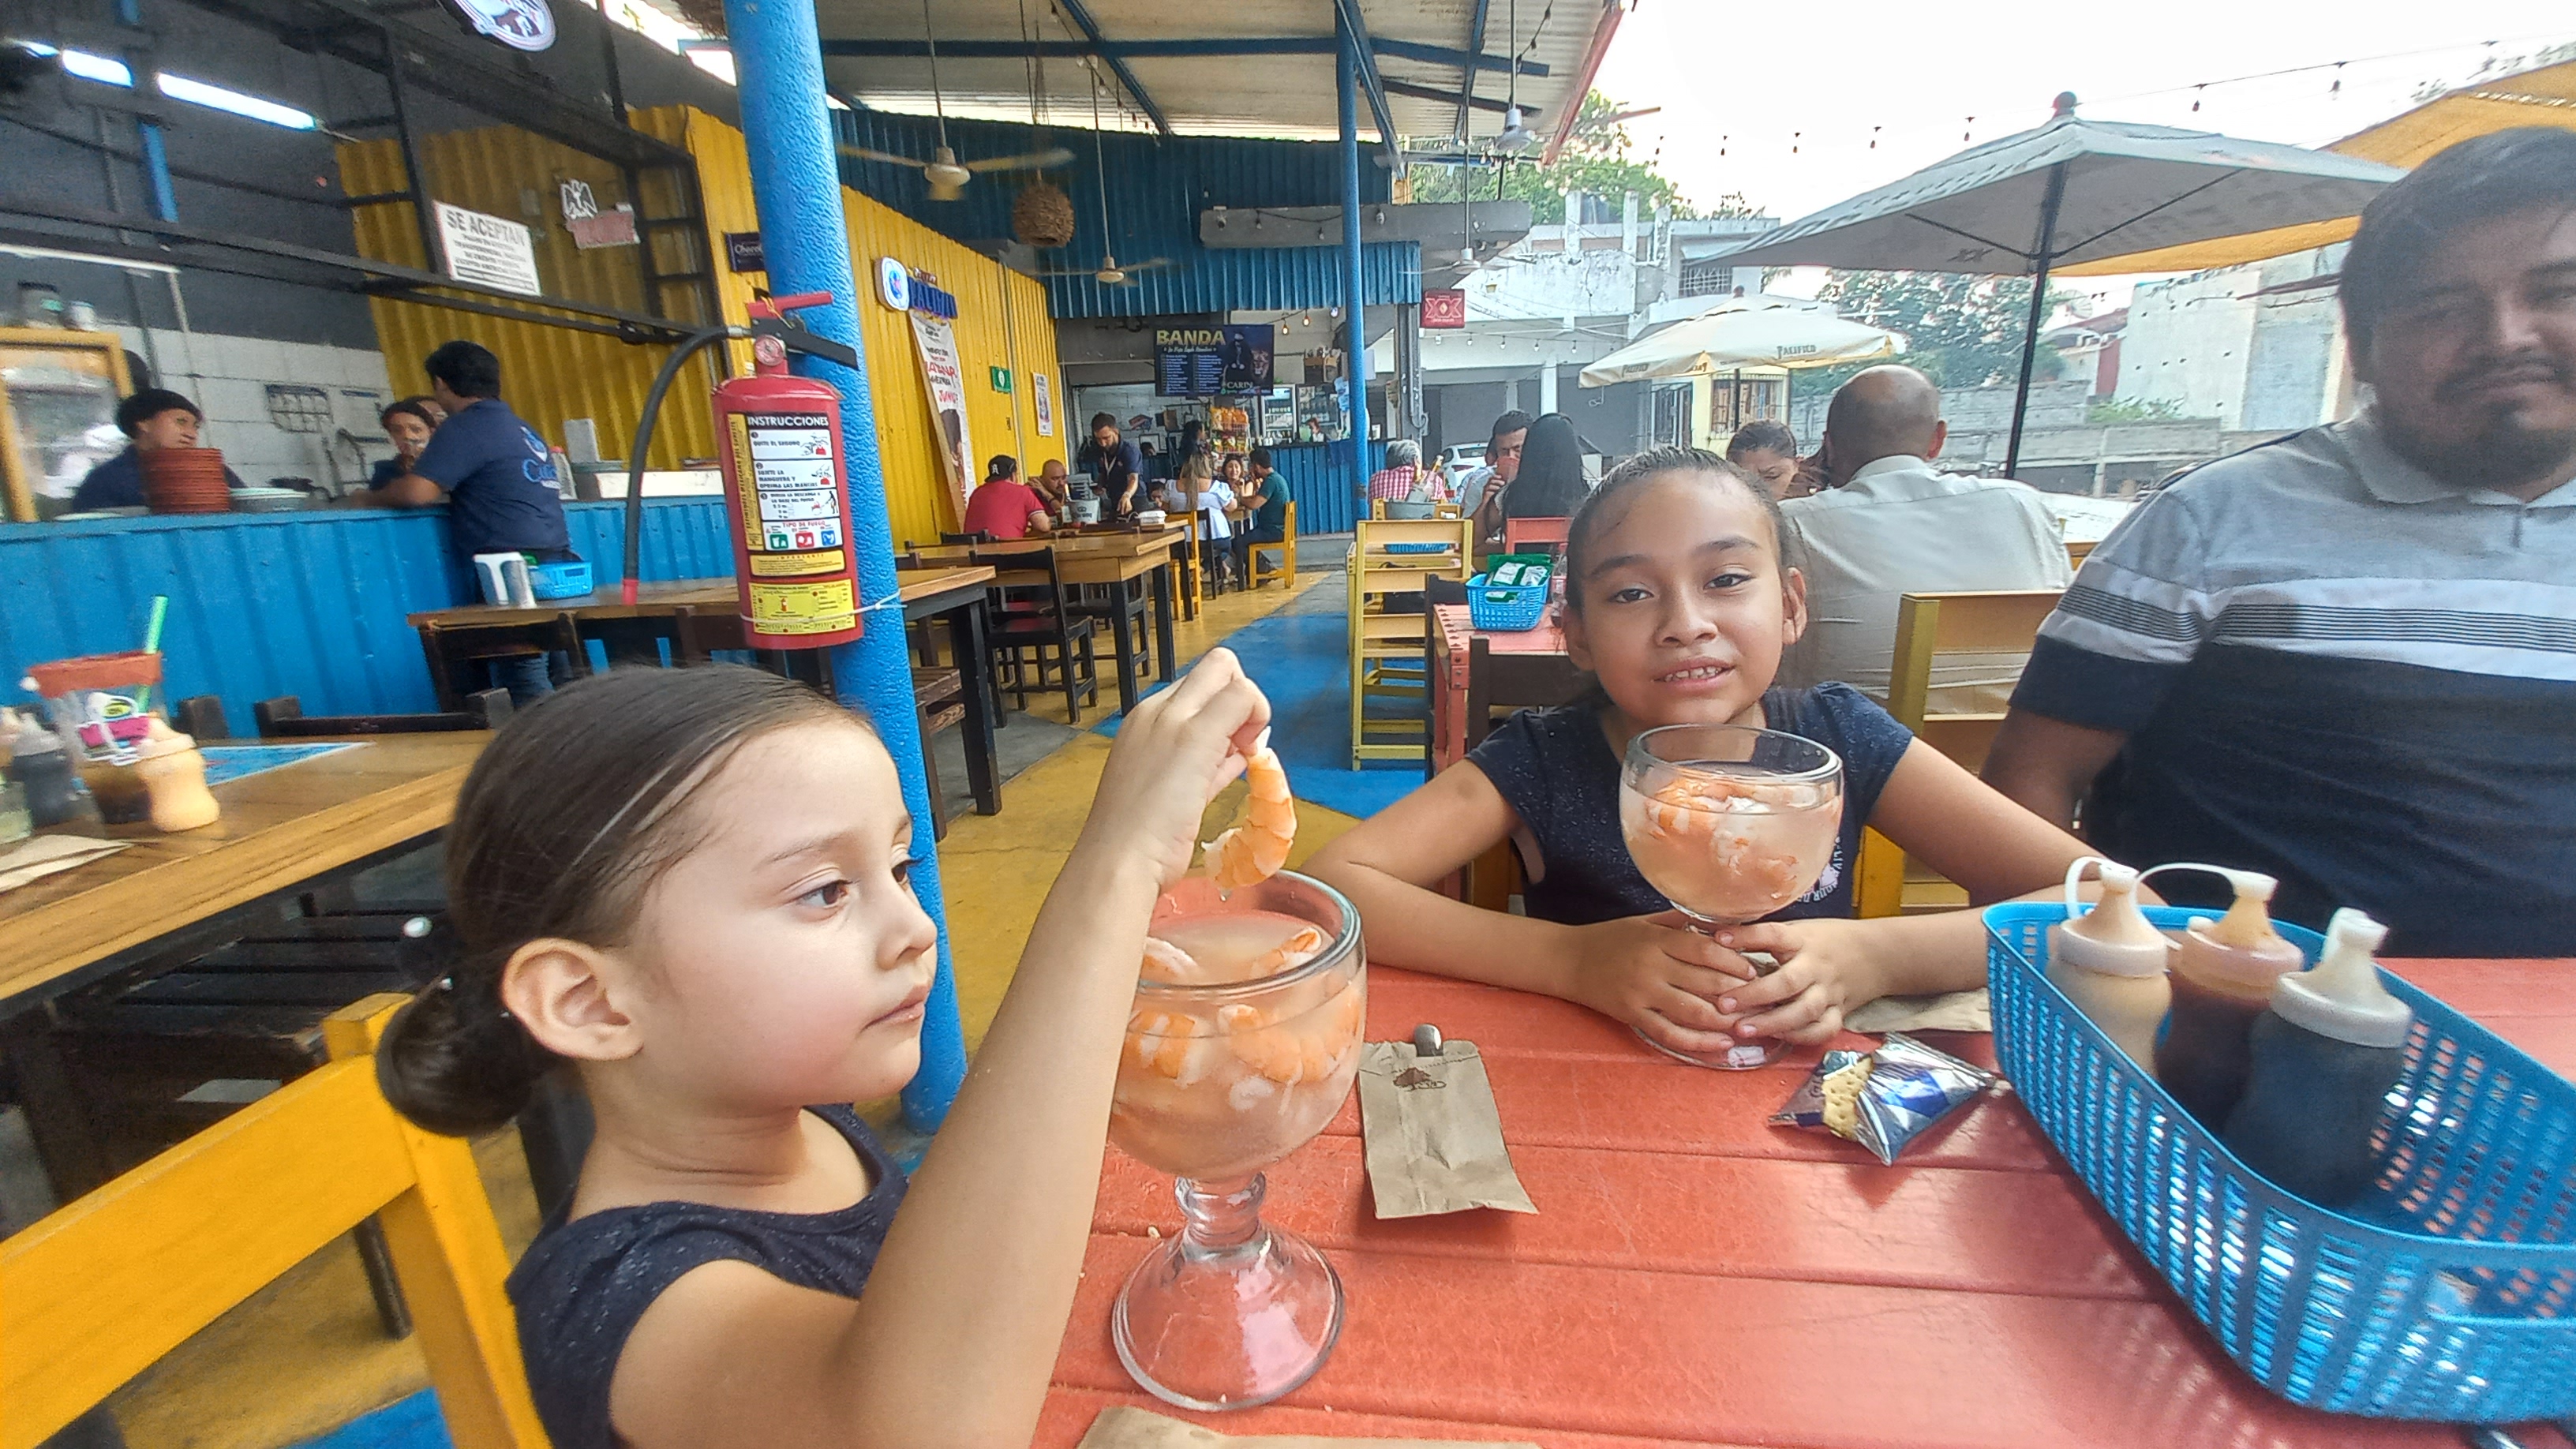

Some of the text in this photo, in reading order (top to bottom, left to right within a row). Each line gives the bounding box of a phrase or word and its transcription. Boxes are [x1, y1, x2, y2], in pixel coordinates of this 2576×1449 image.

[446, 209, 466, 231] SE
[469, 215, 526, 246] ACEPTAN
[1156, 330, 1226, 346] BANDA
[1777, 345, 1817, 360] PACIFICO
[747, 416, 829, 426] INSTRUCCIONES
